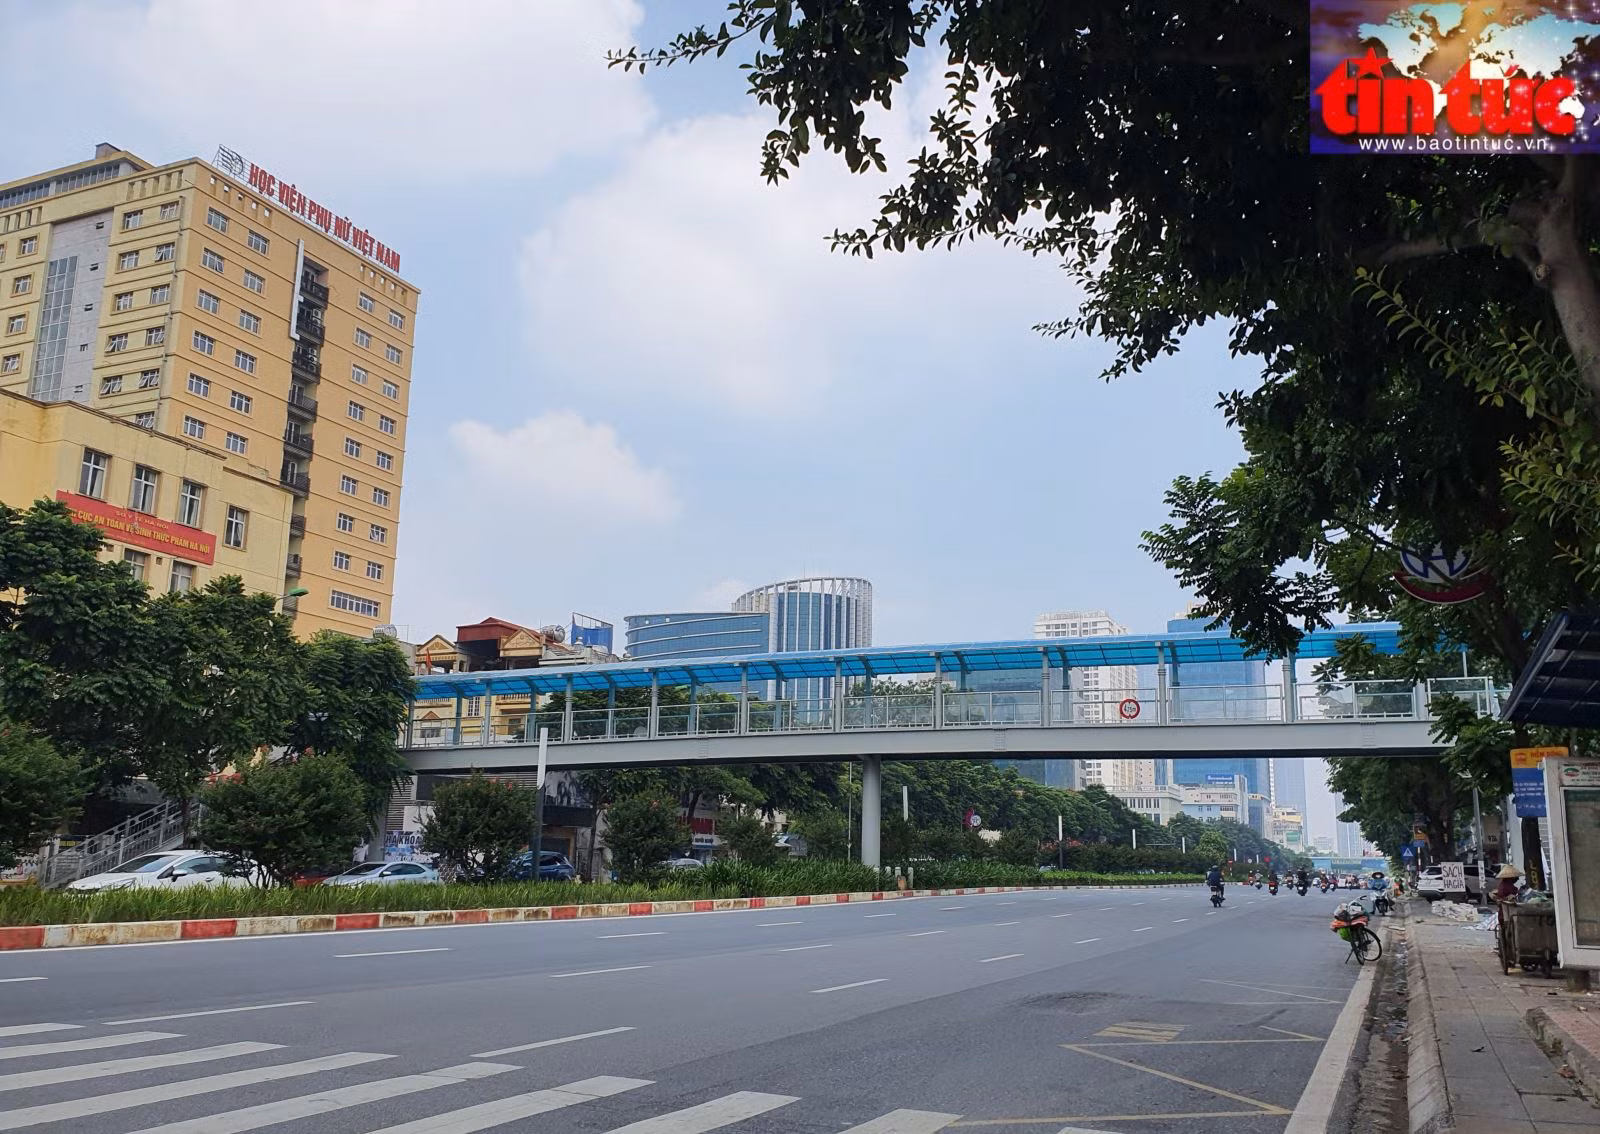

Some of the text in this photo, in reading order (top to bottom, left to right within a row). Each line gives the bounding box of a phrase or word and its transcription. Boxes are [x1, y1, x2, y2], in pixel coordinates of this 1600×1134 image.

[249, 163, 276, 197] HỌC
[278, 180, 307, 214] VIỆN
[376, 241, 401, 273] NAM
[94, 514, 105, 525] AN
[135, 527, 152, 538] SINH
